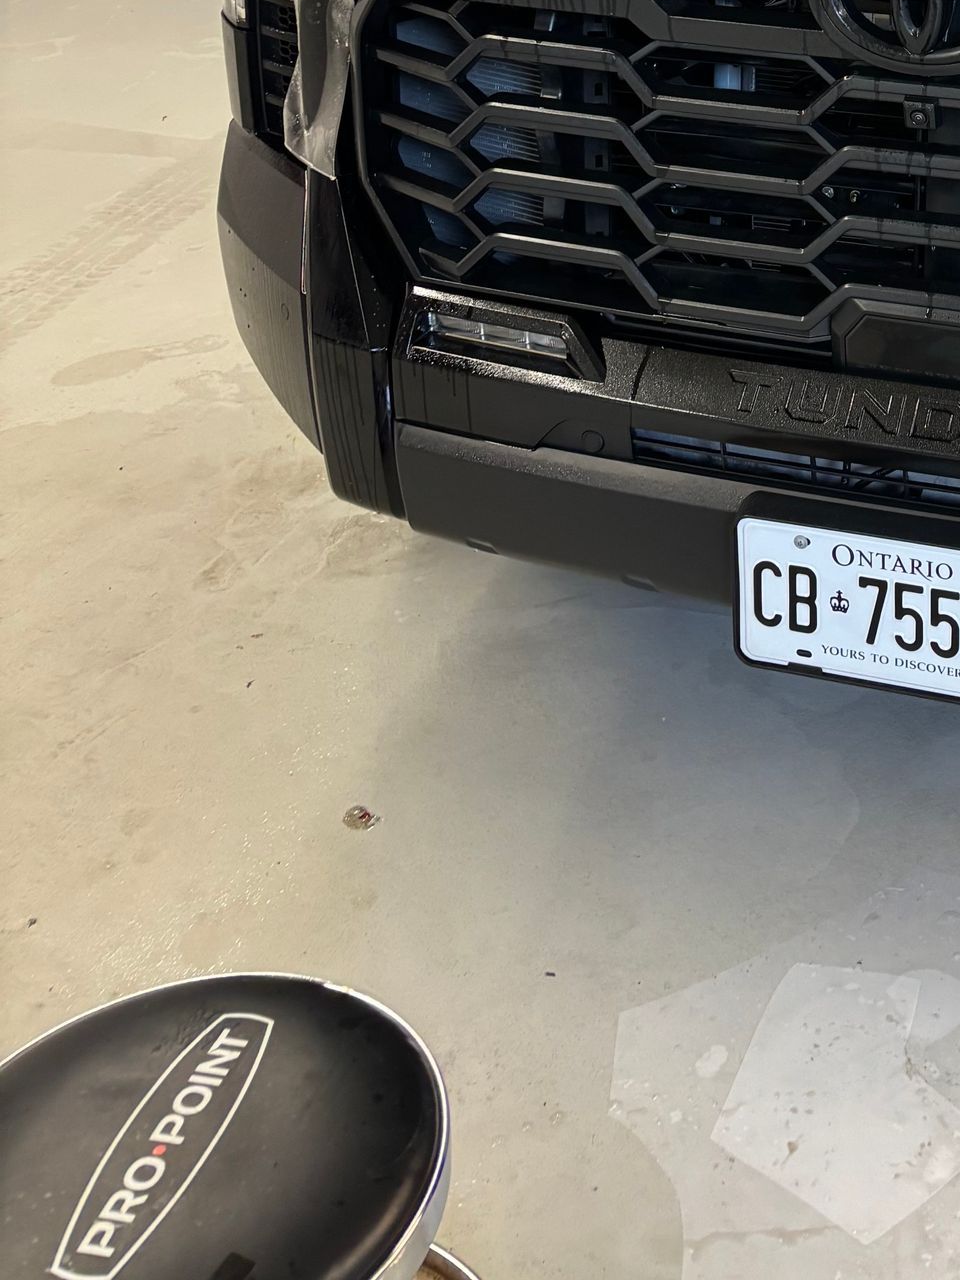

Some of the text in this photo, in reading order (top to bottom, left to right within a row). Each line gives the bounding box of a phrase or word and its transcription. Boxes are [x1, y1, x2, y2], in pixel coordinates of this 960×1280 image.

[753, 560, 818, 634] CB
[821, 644, 866, 661] YOURS
[870, 653, 890, 664] TO
